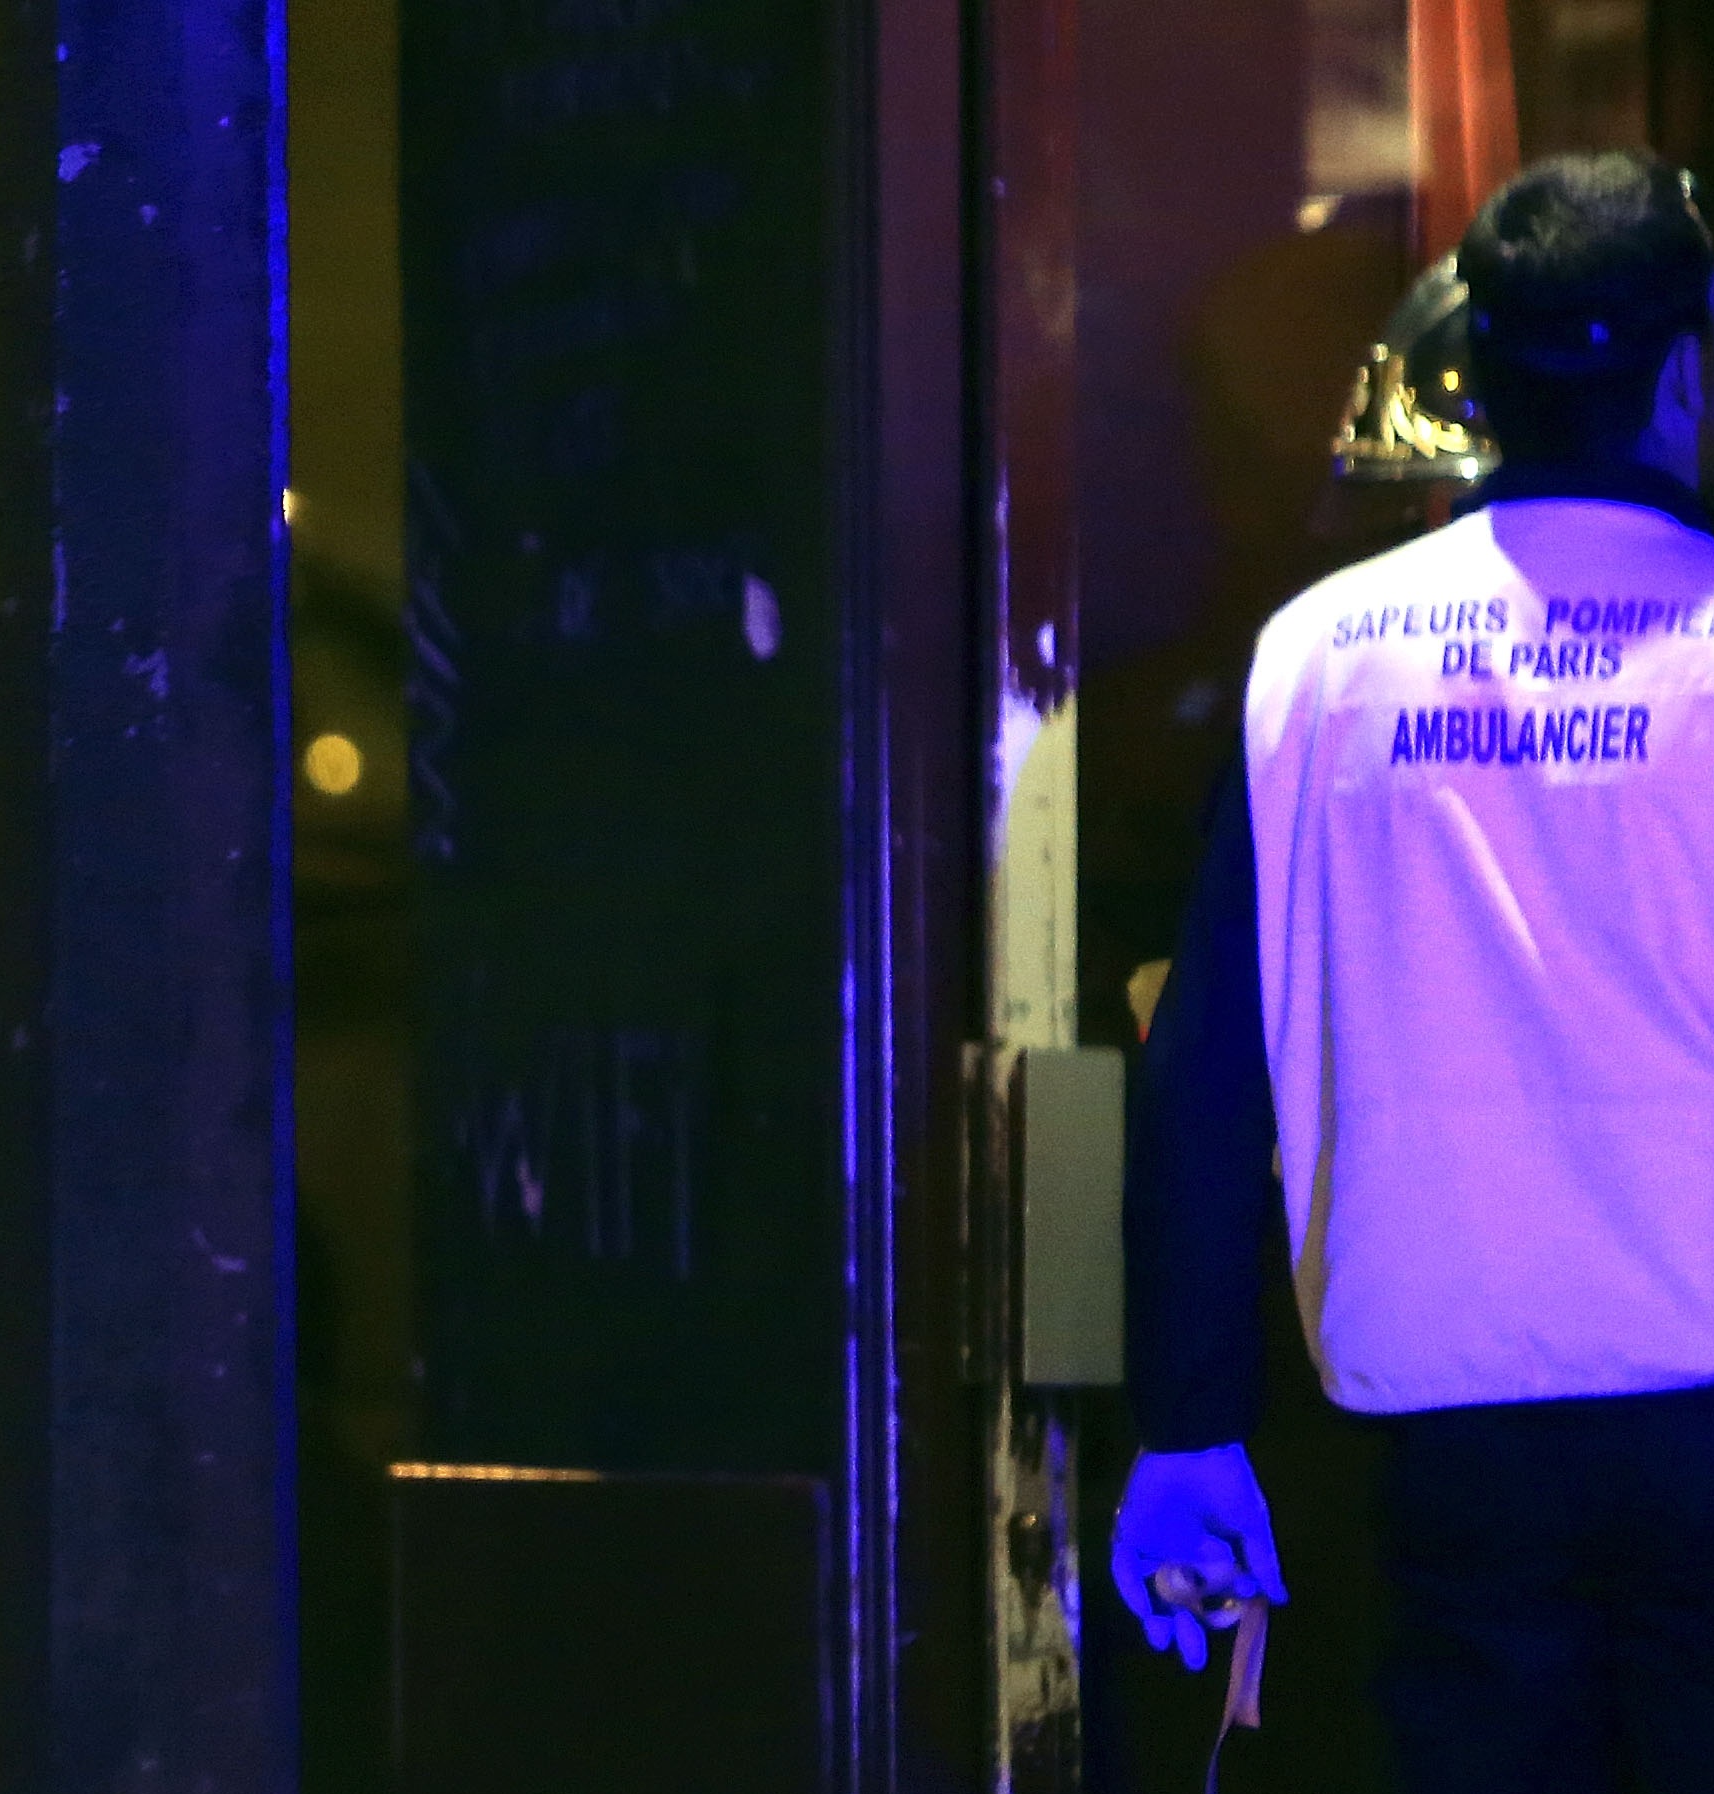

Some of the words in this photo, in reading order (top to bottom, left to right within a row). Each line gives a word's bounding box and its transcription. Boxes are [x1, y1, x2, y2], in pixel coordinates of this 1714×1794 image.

[1333, 599, 1509, 649] SAPEURS
[1442, 641, 1488, 678] DE
[1510, 638, 1623, 680] PARIS
[1390, 706, 1652, 768] AMBULANCIER
